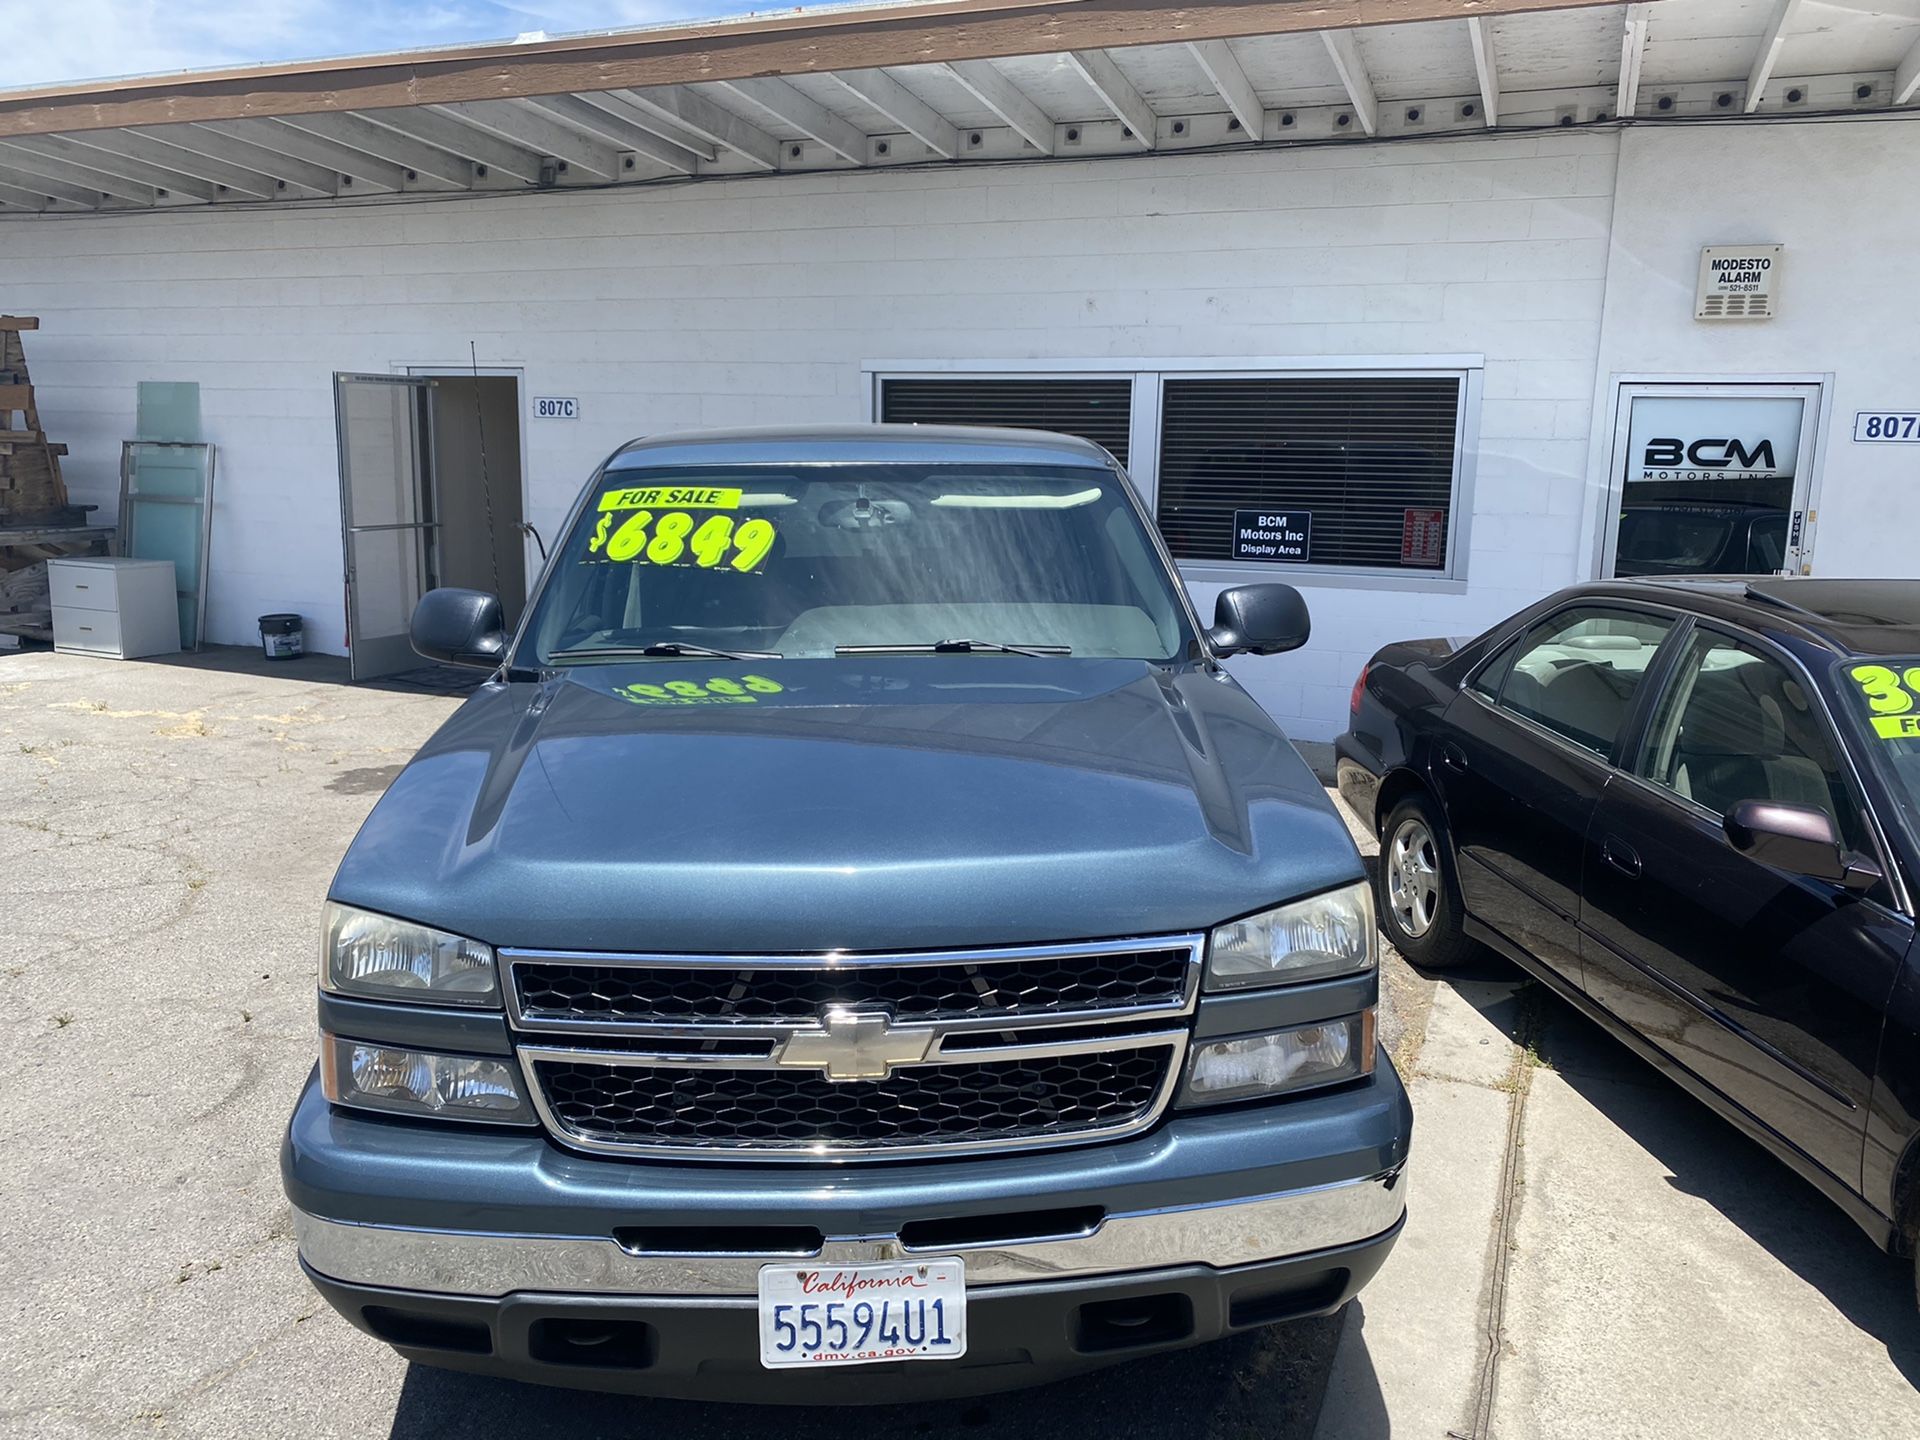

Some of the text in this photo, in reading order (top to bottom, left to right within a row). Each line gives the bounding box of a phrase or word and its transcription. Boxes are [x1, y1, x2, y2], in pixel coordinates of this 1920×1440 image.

[1711, 258, 1771, 271] MODESTO
[1718, 271, 1761, 283] ALARM
[539, 400, 573, 416] 807C
[1866, 416, 1920, 438] 807
[1644, 438, 1776, 468] BCM
[1643, 471, 1725, 480] MOTORS
[616, 489, 725, 506] FOR SALE
[1258, 515, 1287, 527] BCM
[589, 510, 776, 572] $6849
[1240, 529, 1304, 541] Motors Inc
[1241, 544, 1301, 555] Display Area
[1899, 718, 1920, 733] F
[802, 1271, 928, 1298] California
[774, 1298, 951, 1352] 55594U1
[813, 1347, 917, 1361] dmv.ca.gov
